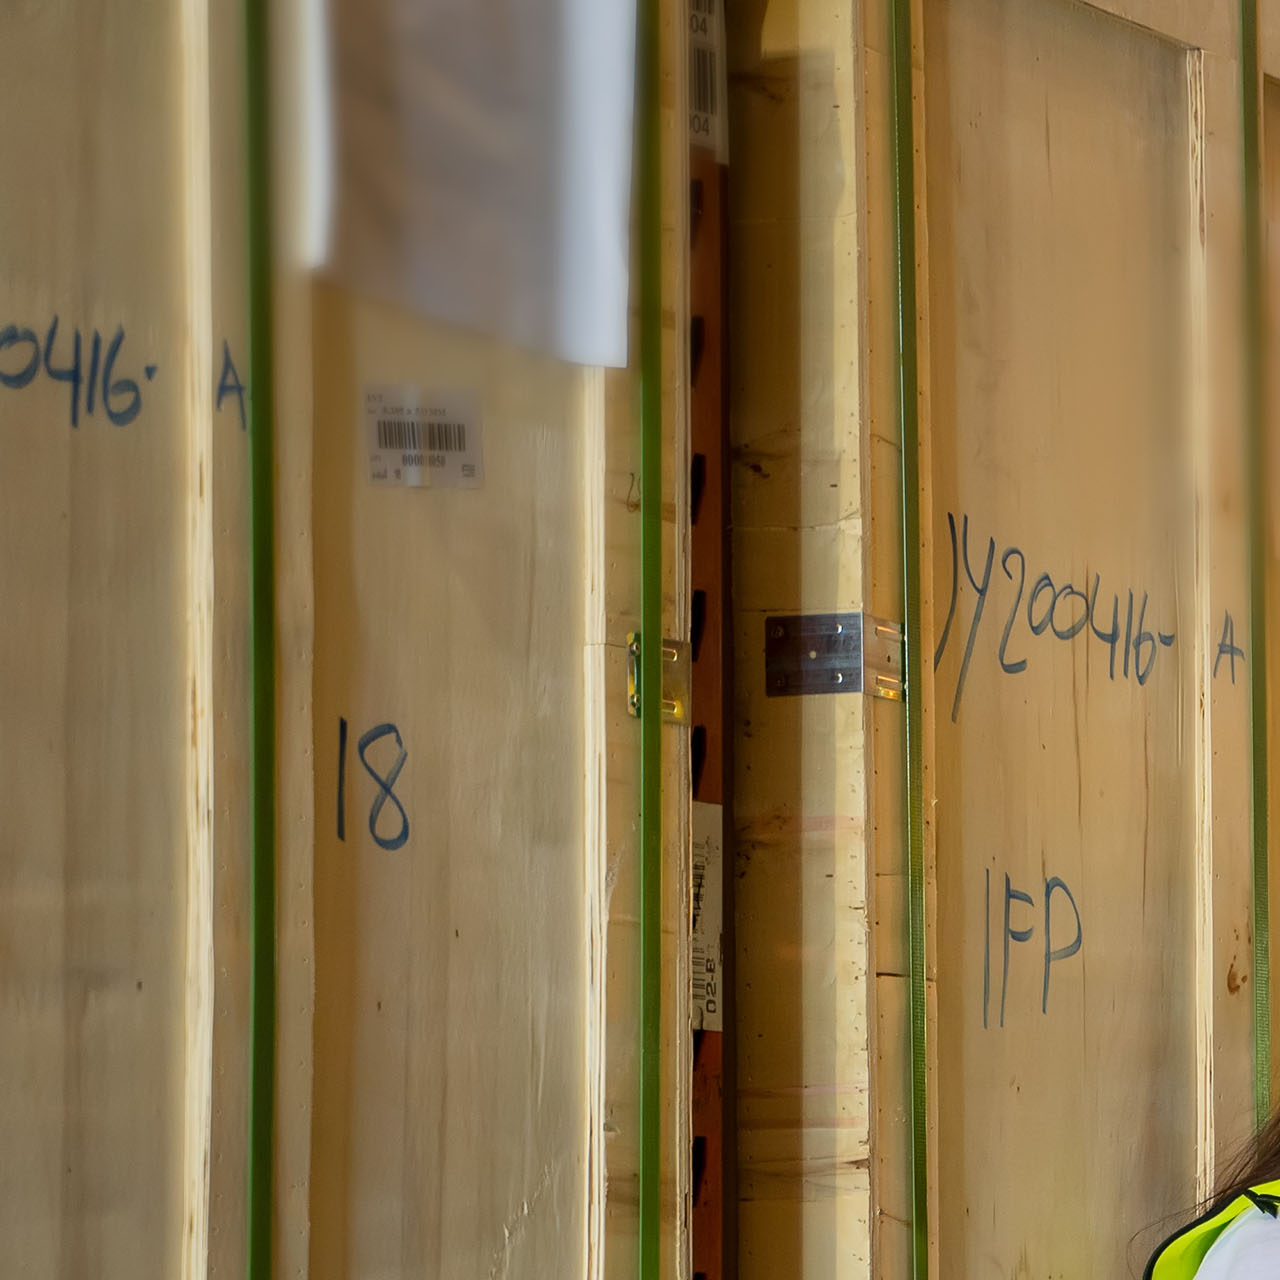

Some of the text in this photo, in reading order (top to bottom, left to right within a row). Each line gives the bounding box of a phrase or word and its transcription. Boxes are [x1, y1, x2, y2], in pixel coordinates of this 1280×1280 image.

[216, 338, 247, 431] A
[1212, 609, 1246, 685] A
[337, 716, 410, 851] 18
